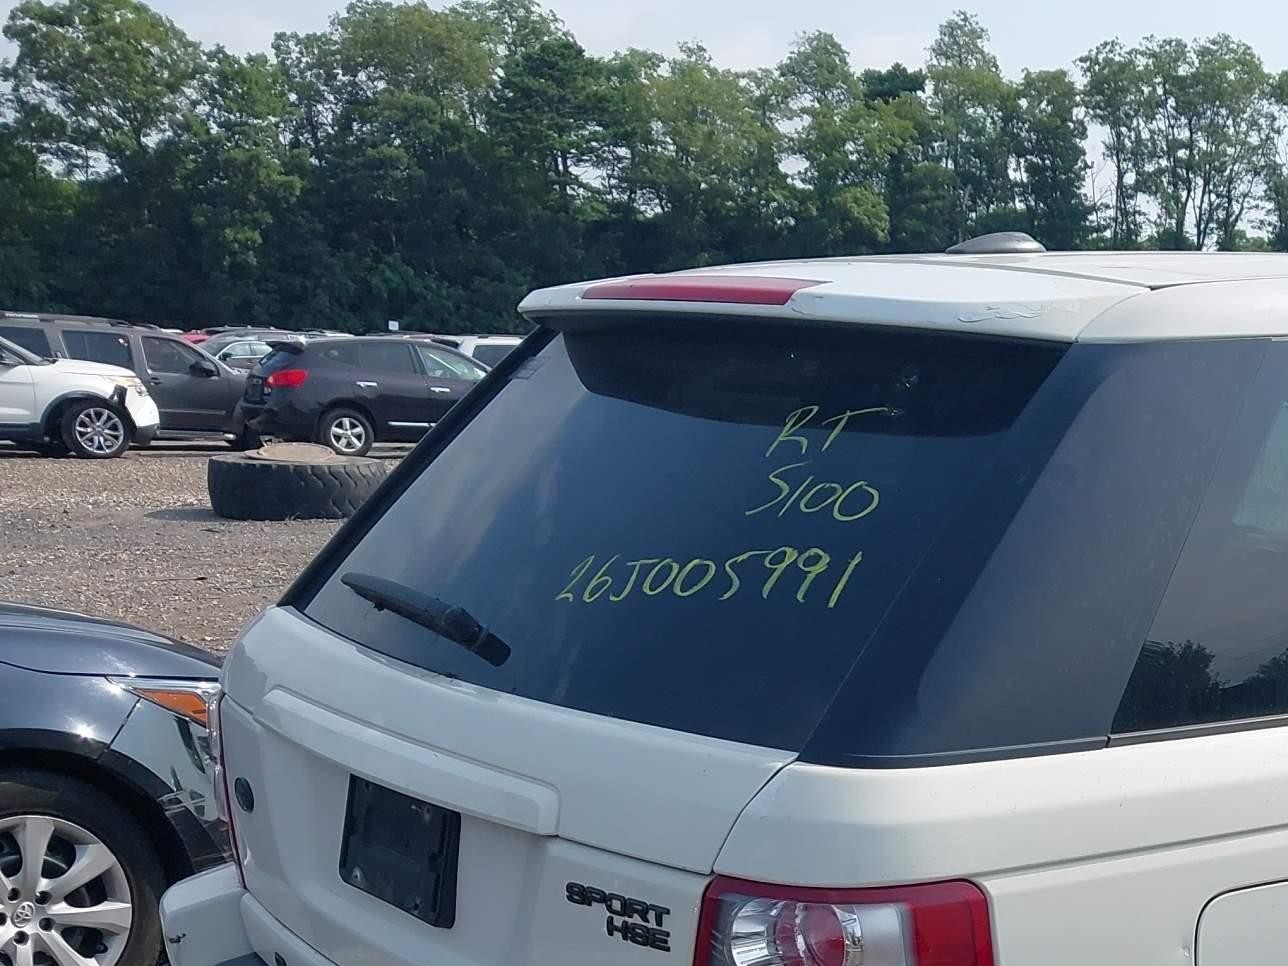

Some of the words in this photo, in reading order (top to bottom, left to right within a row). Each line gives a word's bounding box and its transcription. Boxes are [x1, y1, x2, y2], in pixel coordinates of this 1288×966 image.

[766, 404, 890, 457] RT
[556, 546, 864, 608] 26J005991
[565, 881, 671, 928] SPORT
[606, 915, 671, 953] HSE
